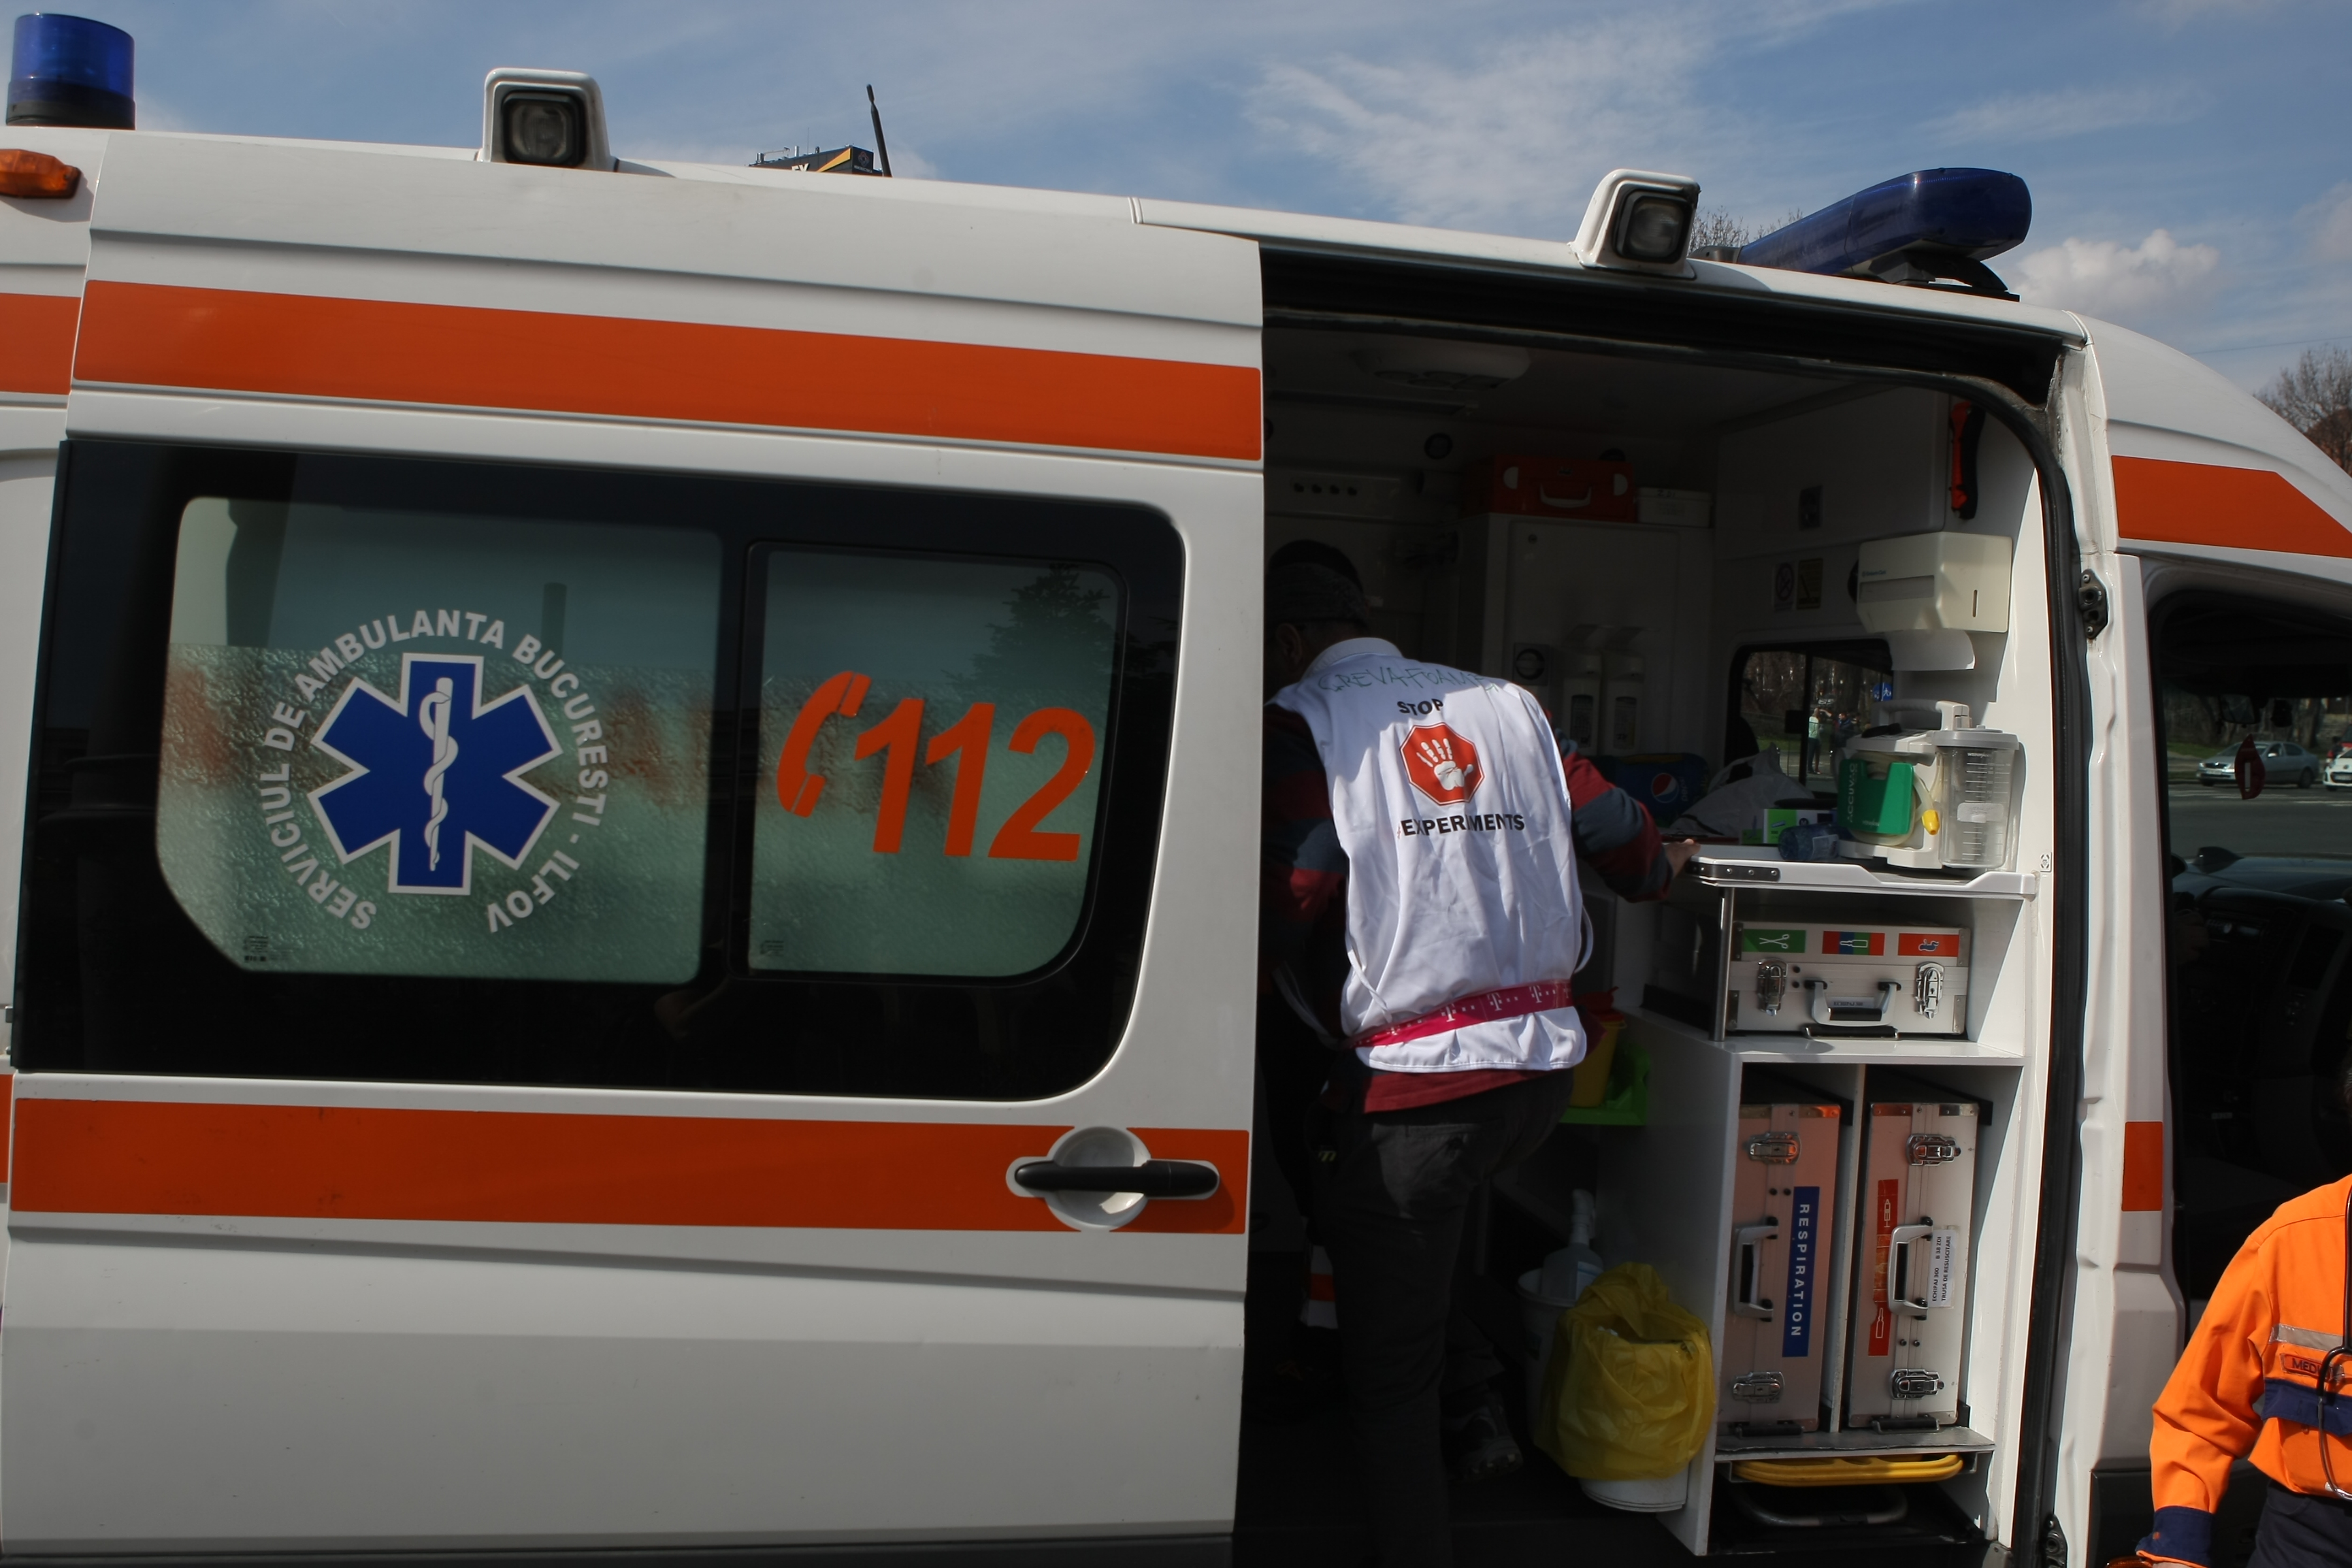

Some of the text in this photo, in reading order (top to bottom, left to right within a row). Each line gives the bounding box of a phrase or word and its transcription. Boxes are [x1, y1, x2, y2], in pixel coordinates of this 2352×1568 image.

[294, 609, 505, 702] AMBULANTA
[264, 702, 306, 751] DE
[512, 634, 608, 826] BUCURESTI
[1396, 698, 1443, 715] STOP
[854, 698, 1096, 862] 112
[259, 763, 377, 929] SERVICIUL
[1401, 813, 1524, 836] EXPERIMENTS
[486, 849, 580, 932] ILFOV
[1791, 1204, 1810, 1336] RESPIRATION
[2292, 1357, 2320, 1374] MEDI
